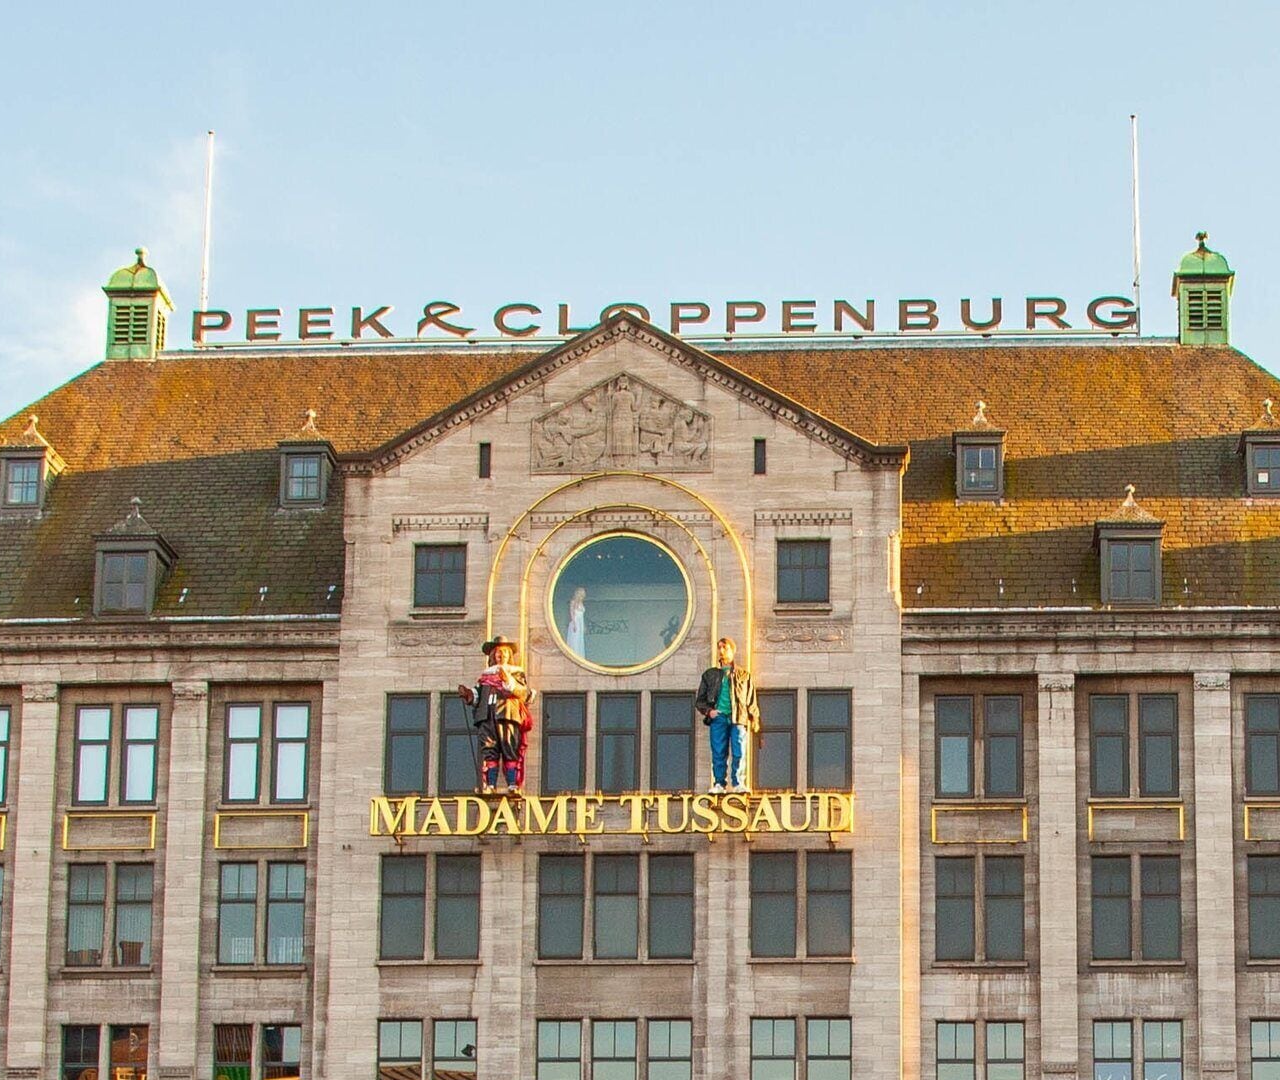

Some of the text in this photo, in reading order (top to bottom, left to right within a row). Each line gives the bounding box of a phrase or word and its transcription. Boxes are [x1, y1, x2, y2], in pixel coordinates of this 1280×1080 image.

[192, 296, 1137, 341] PEEK & CLOPPENBURG
[370, 792, 854, 836] MADAME TUSSAUD
